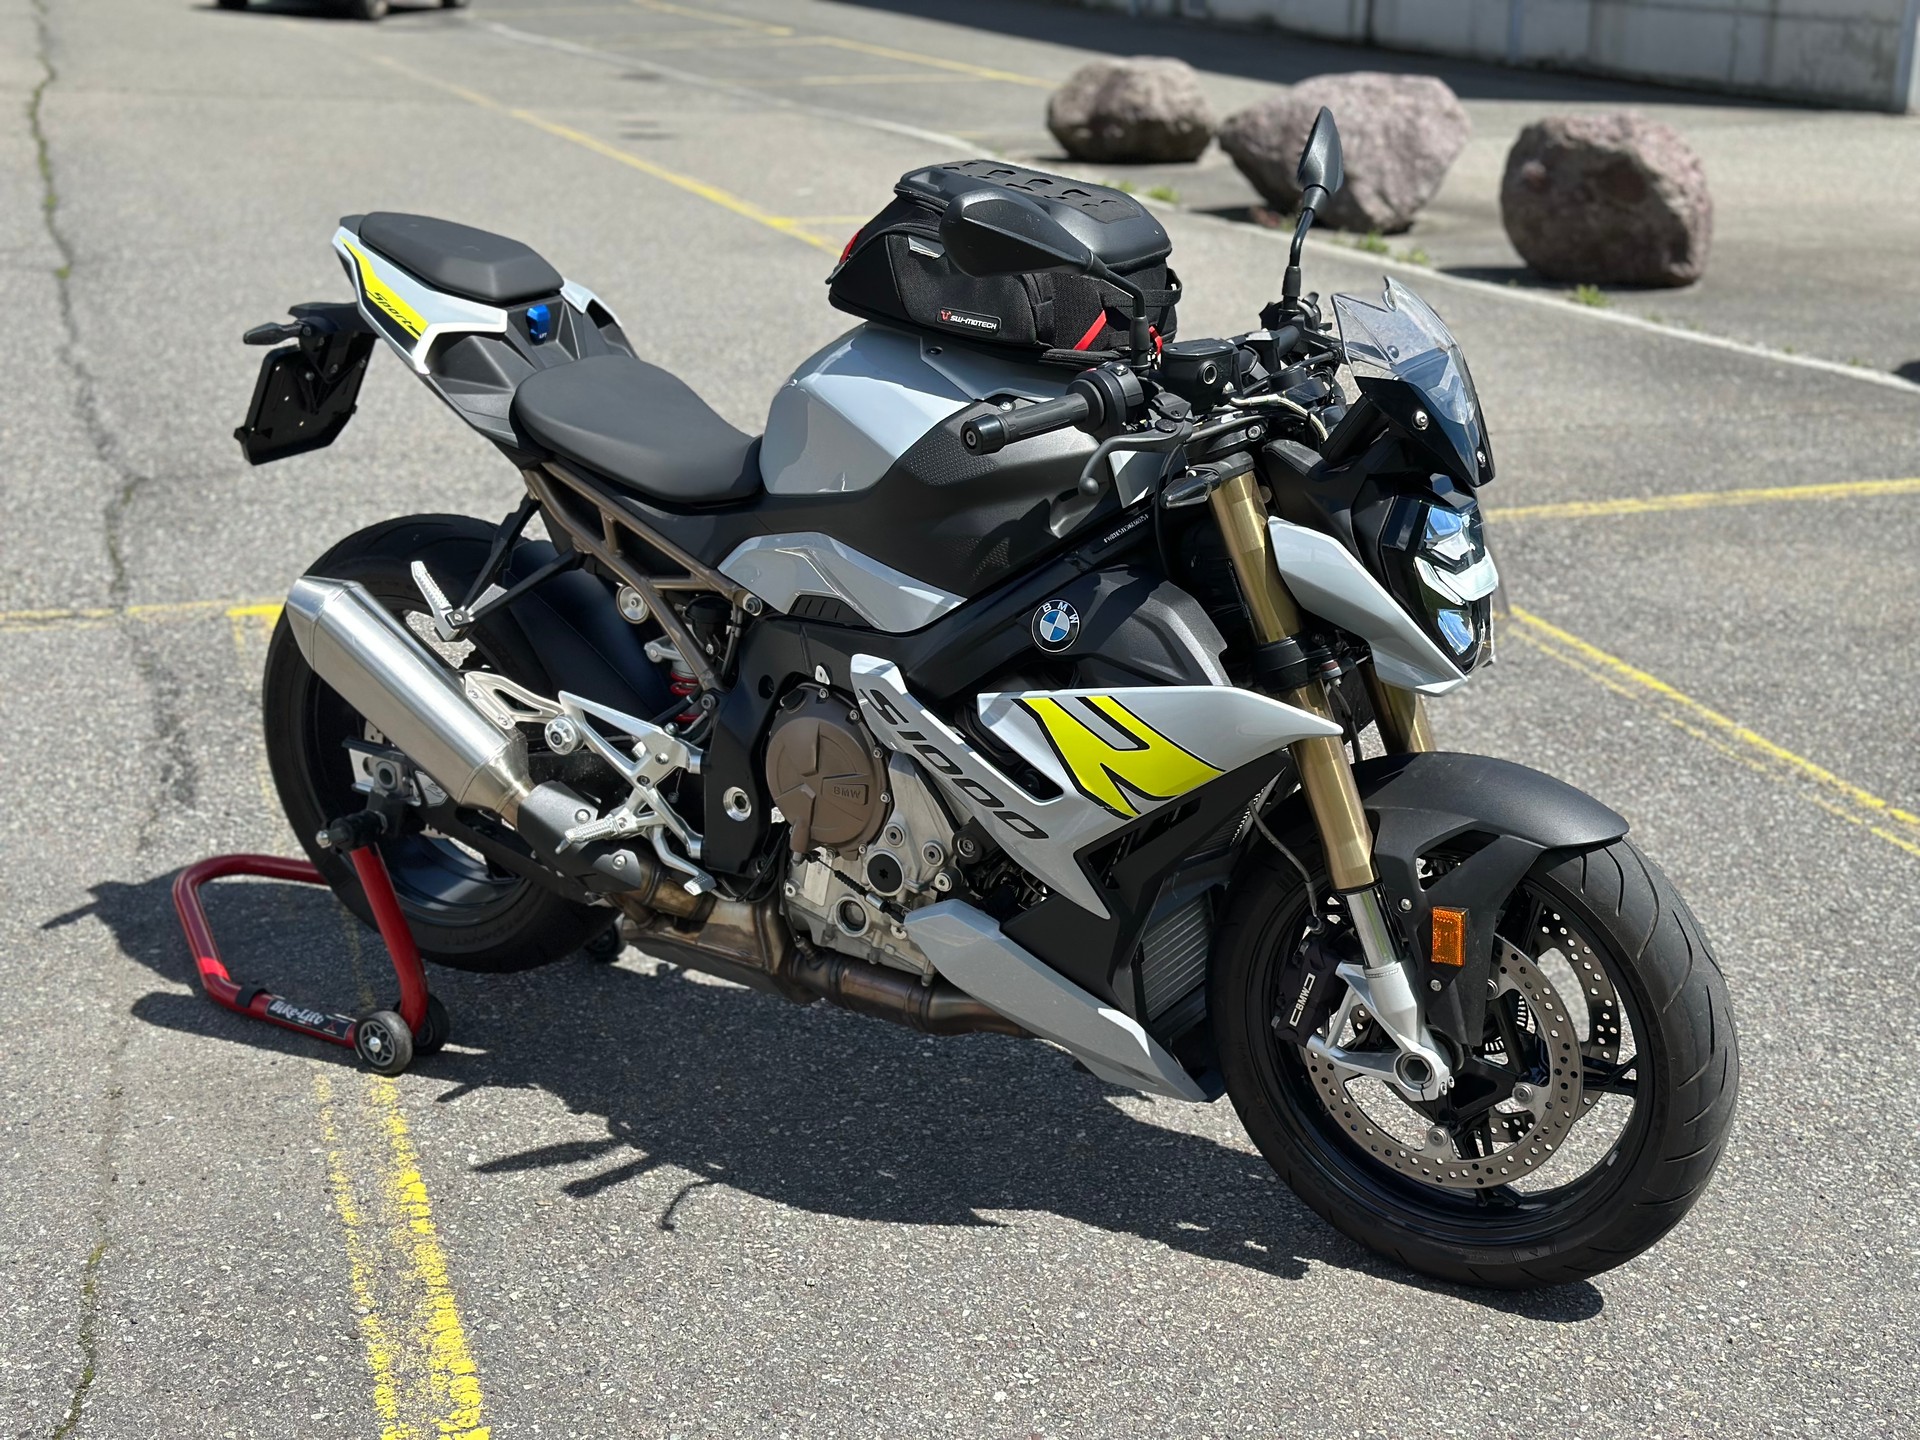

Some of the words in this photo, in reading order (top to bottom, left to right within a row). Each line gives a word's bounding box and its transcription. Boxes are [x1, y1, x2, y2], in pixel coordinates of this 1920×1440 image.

[367, 290, 415, 329] Sport
[949, 315, 997, 330] SW-MOTECH
[1042, 601, 1079, 624] BMW
[859, 688, 1050, 839] S1000
[833, 785, 861, 799] BMW
[1295, 986, 1310, 1011] BMW
[269, 1000, 325, 1025] Bike-Lift
